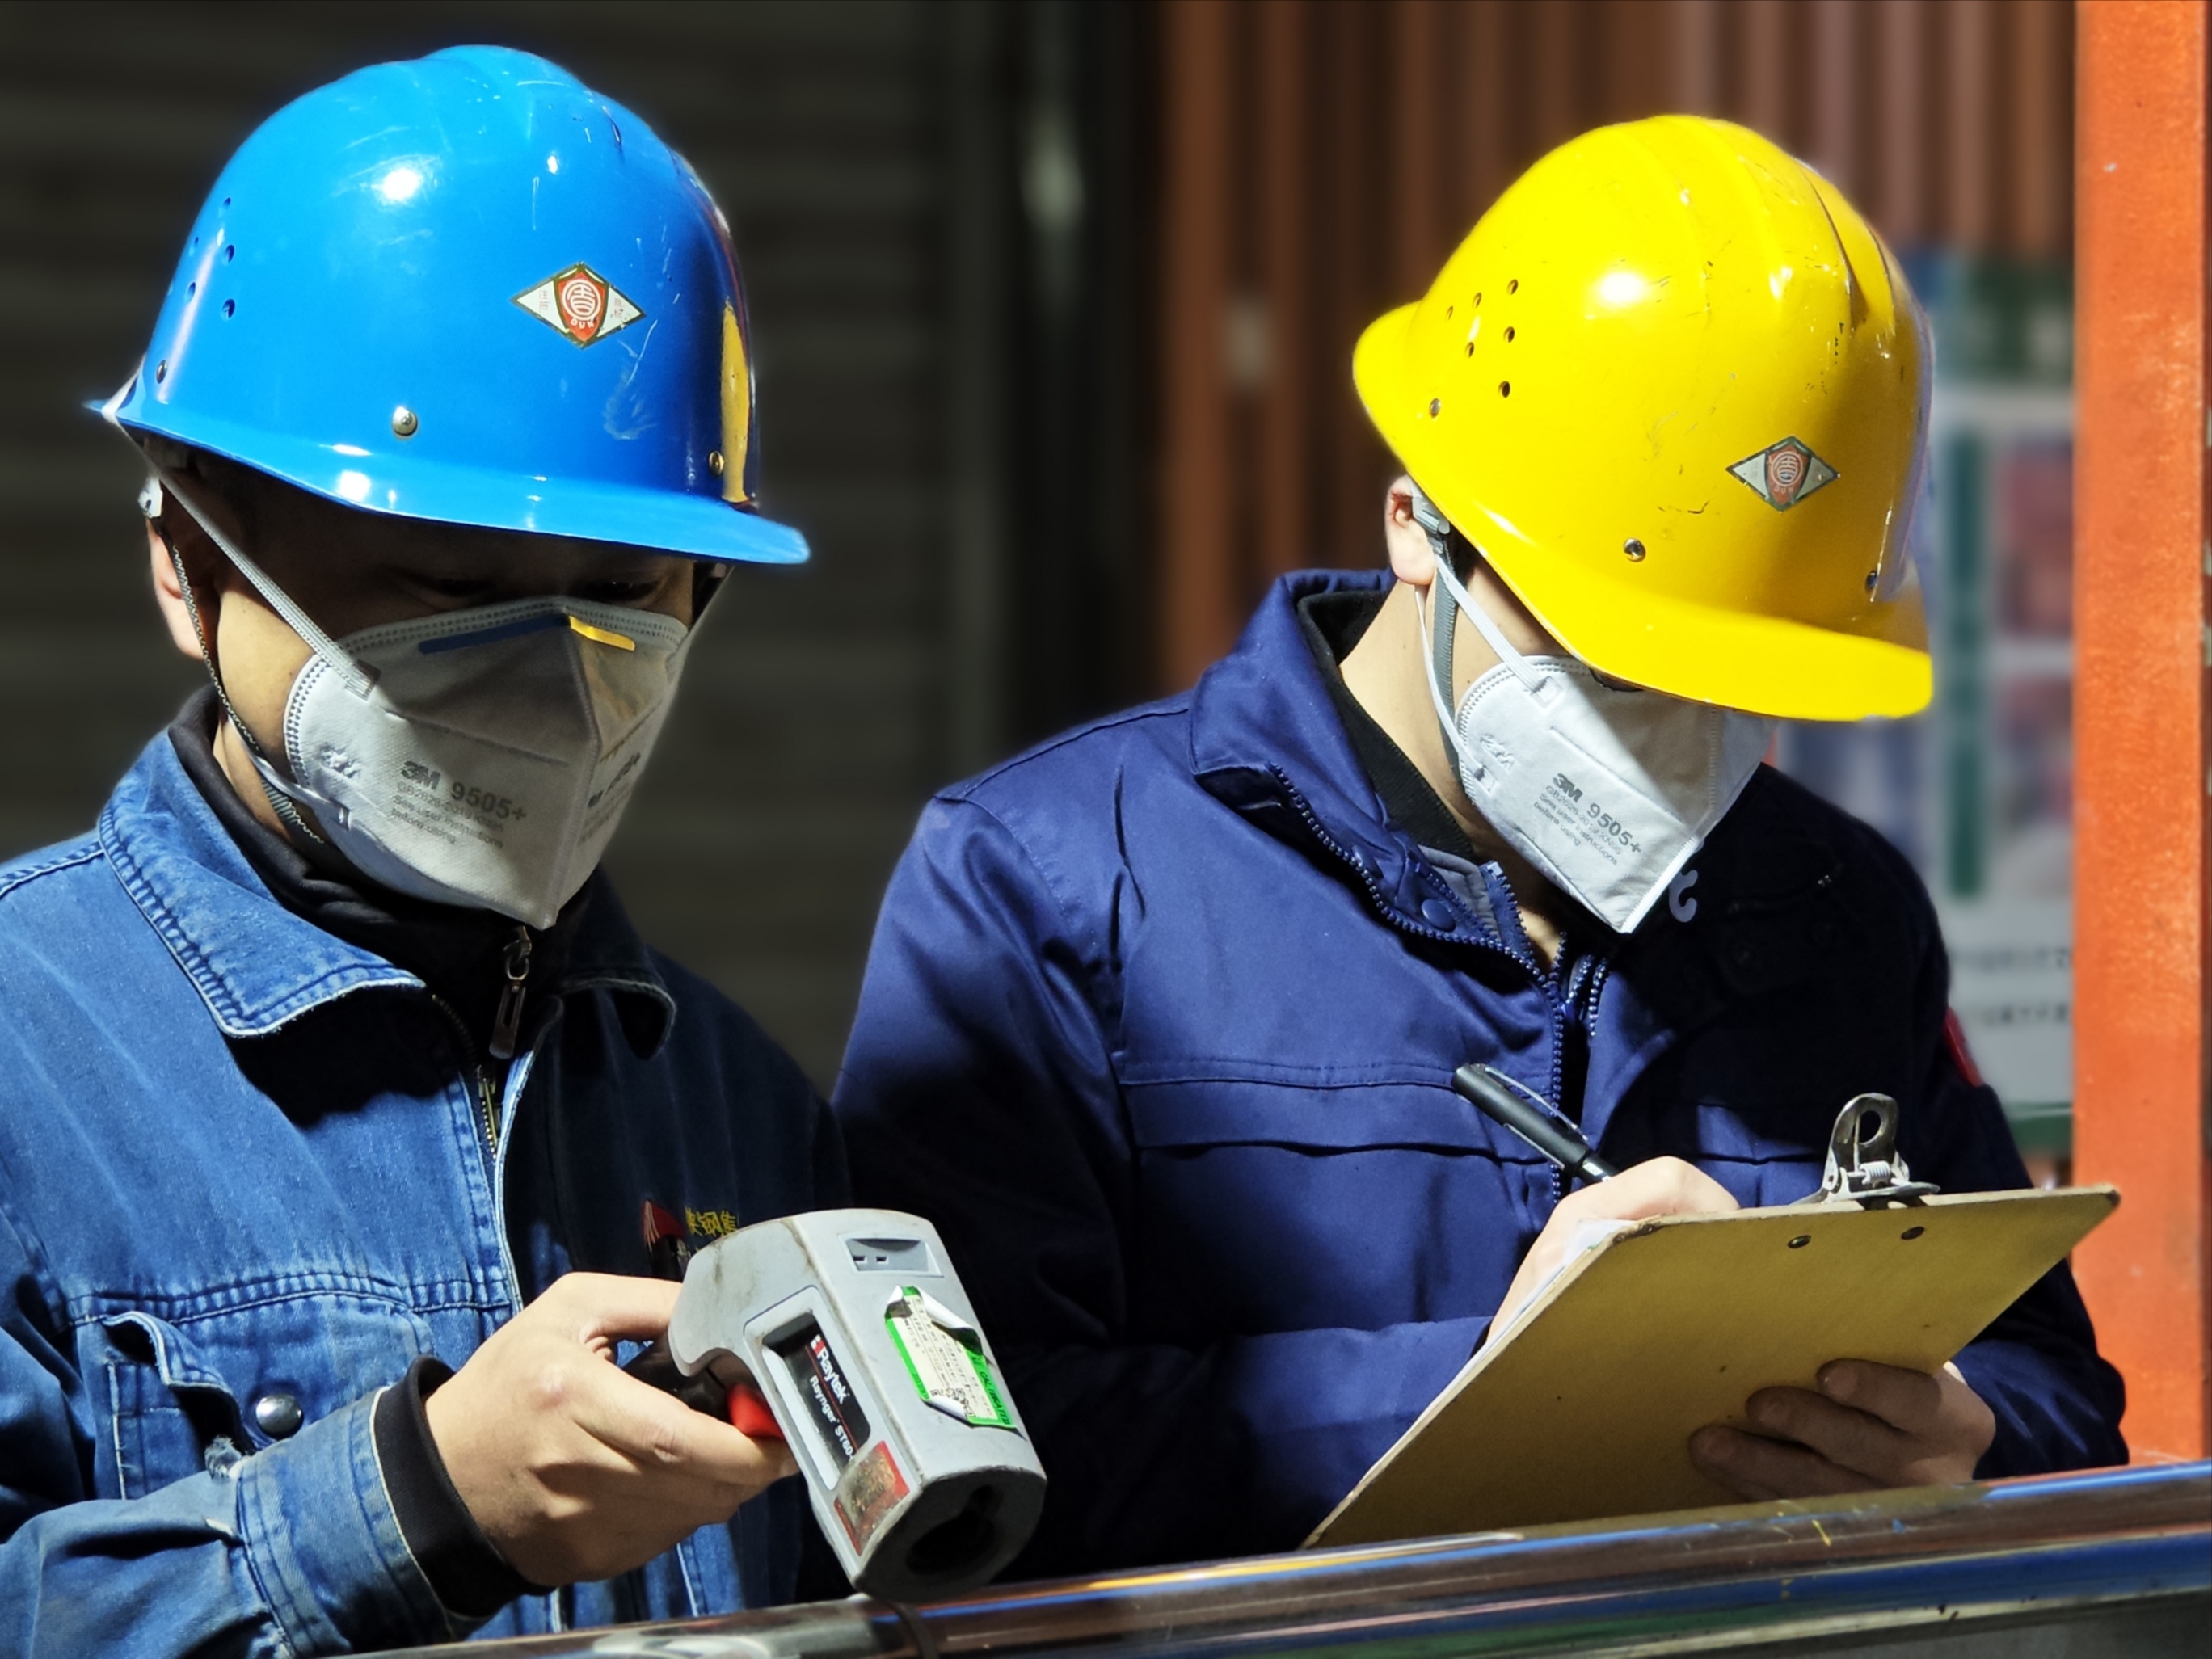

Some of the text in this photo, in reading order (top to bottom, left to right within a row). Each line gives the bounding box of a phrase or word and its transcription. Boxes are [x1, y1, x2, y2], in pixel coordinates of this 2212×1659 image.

[400, 760, 527, 823] 3M 9505+
[1553, 773, 1642, 853] 3M 9505+
[1557, 810, 1576, 826] user
[815, 1350, 849, 1404] Raytek
